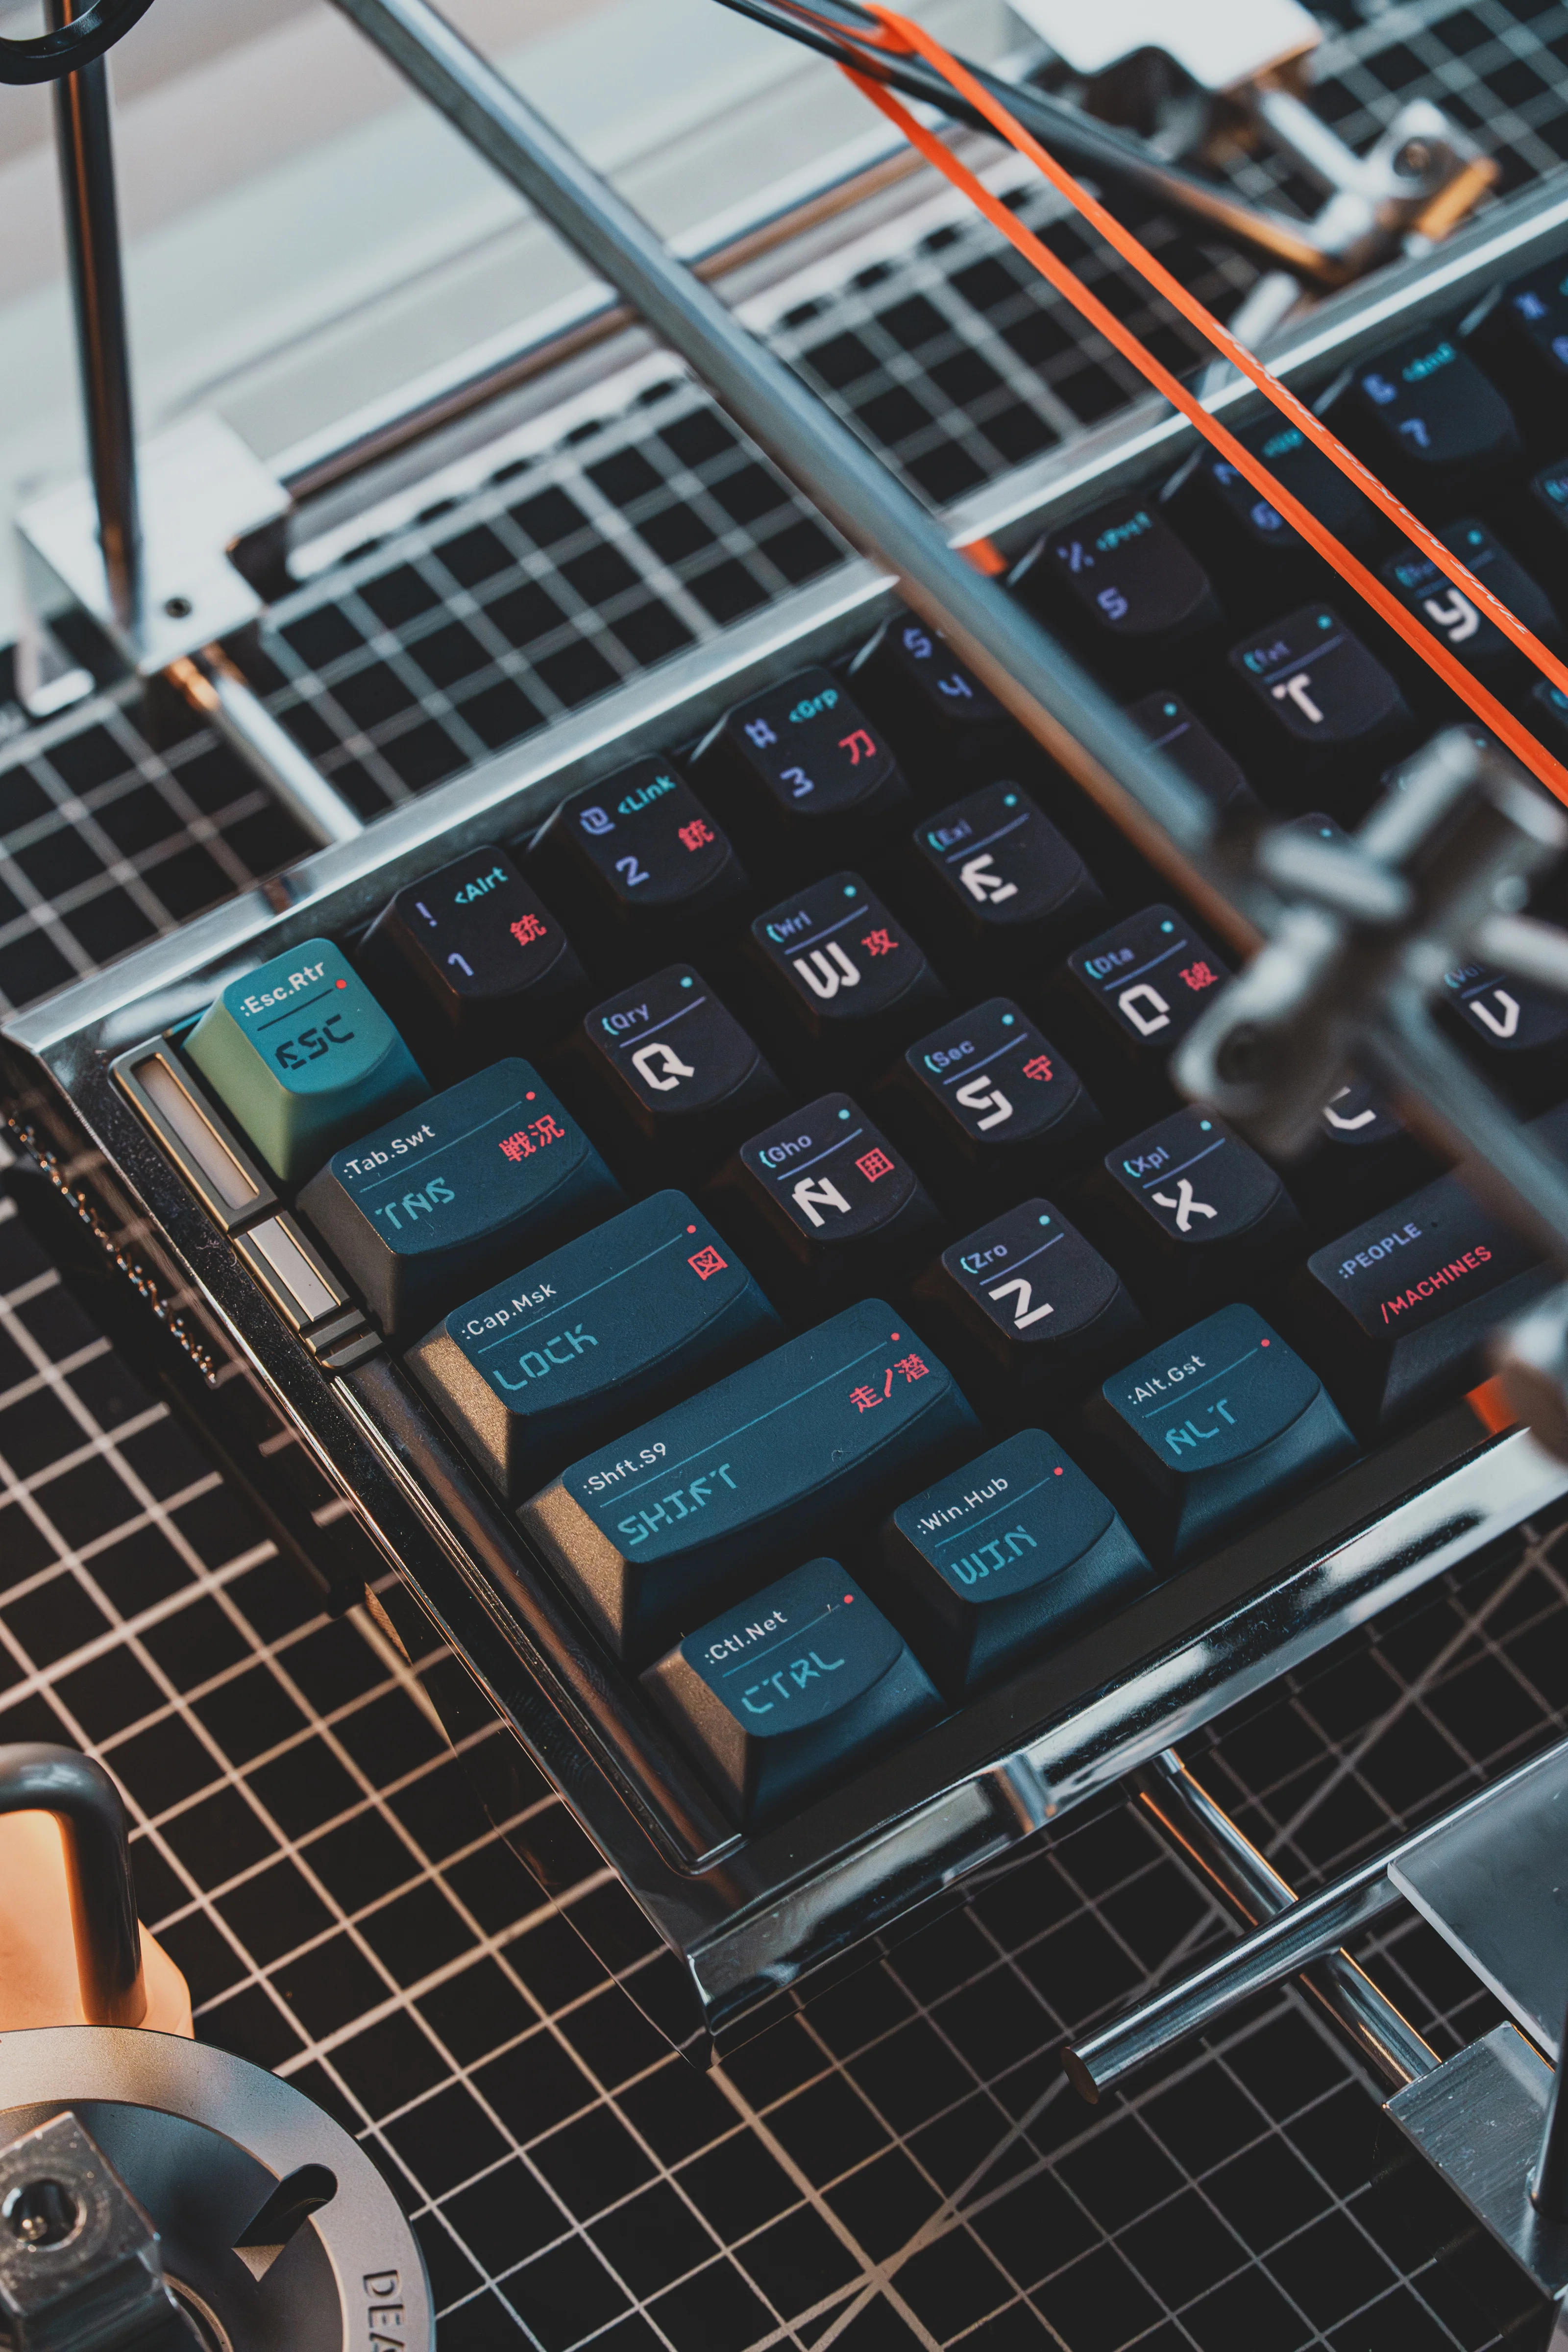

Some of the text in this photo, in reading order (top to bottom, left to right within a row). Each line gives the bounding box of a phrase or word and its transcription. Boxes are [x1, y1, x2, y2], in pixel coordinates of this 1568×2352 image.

[780, 766, 814, 798] 3
[580, 806, 615, 835] @
[615, 856, 650, 887] 2
[416, 902, 438, 927] !
[447, 953, 474, 977] 1
[792, 941, 861, 999] W
[275, 1014, 355, 1070] ESC
[632, 1042, 695, 1092] Q
[343, 1125, 435, 1178] :Tab.Swt
[498, 1114, 564, 1162] 戦況
[1152, 1178, 1218, 1232] X
[462, 1282, 556, 1340] :Cap.Msk
[492, 1323, 598, 1391] LOCK
[617, 1463, 737, 1545] SHIFT
[917, 1475, 1009, 1535] :Win.Hub
[740, 1651, 846, 1715] CTRL
